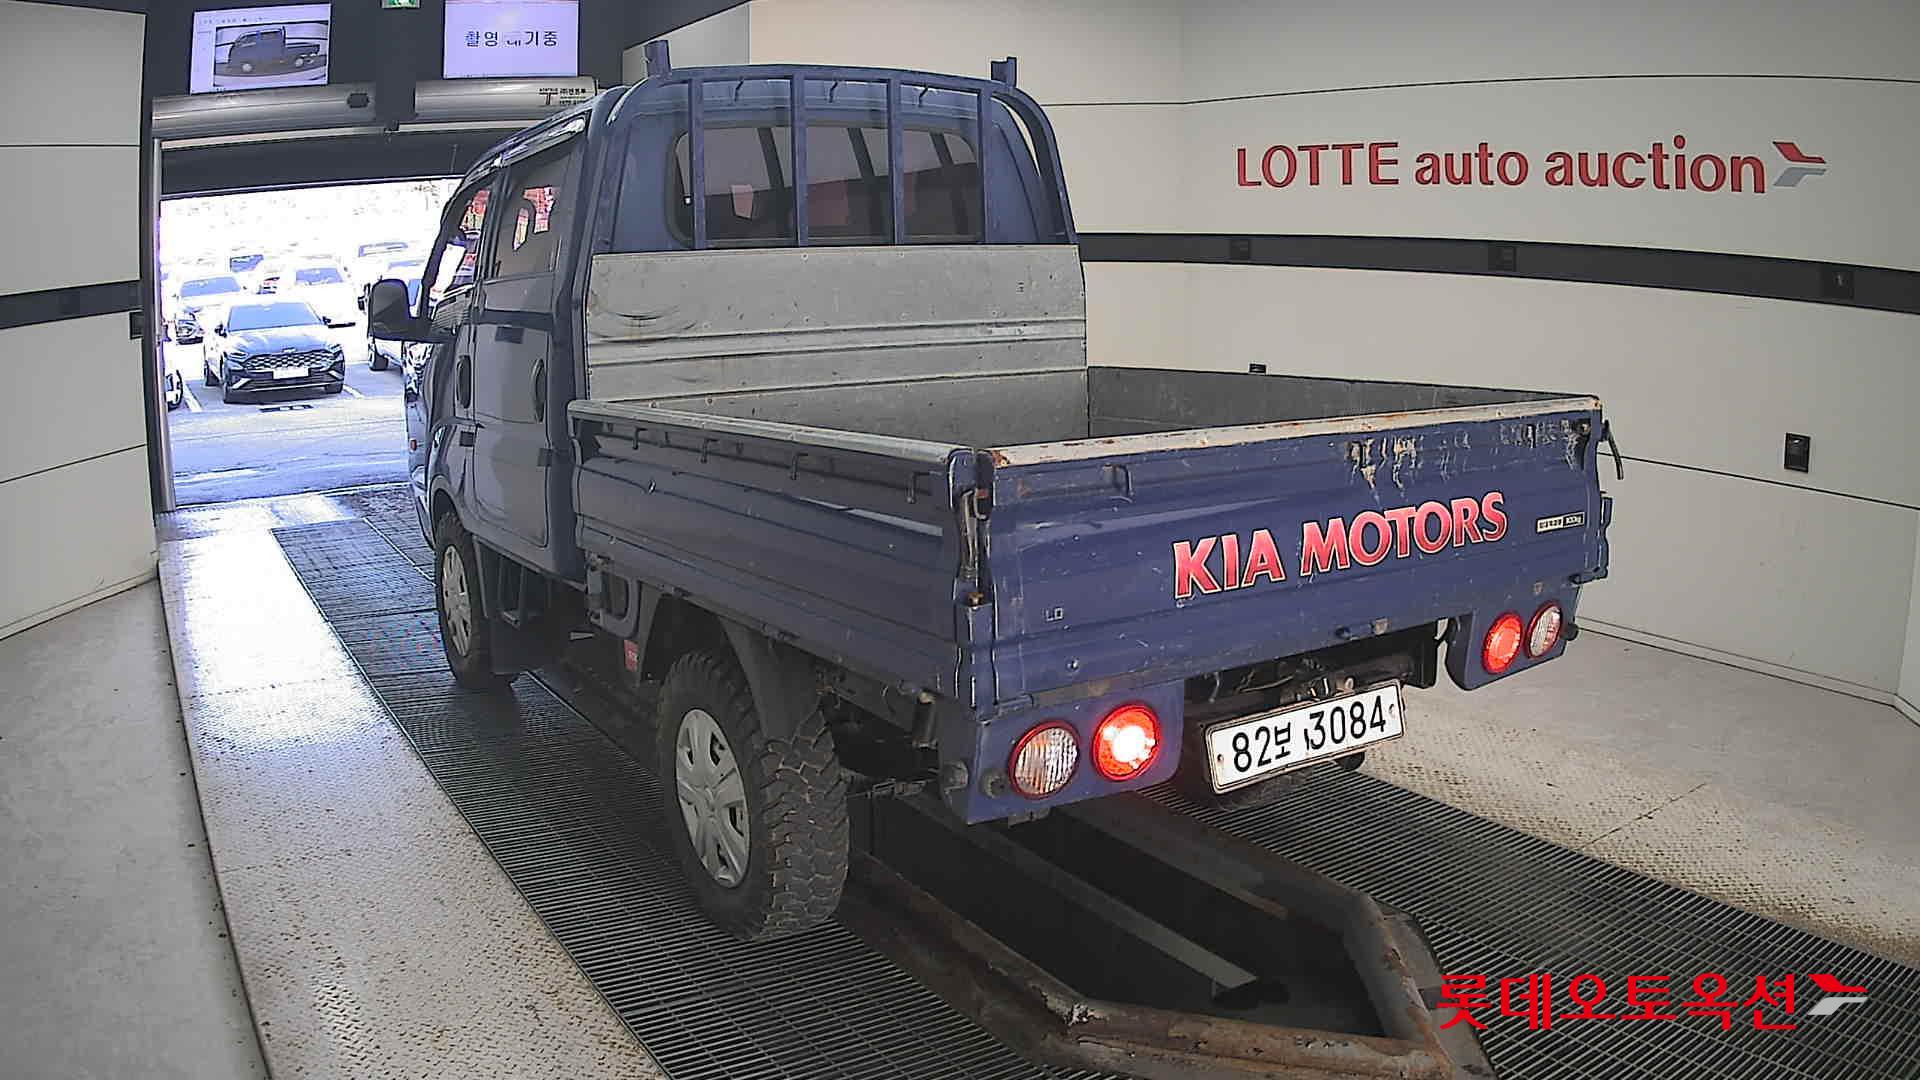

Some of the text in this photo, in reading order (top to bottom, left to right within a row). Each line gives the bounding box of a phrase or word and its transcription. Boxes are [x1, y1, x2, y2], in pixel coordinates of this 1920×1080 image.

[1237, 135, 1766, 194] LOTTE auto auction
[1172, 490, 1510, 600] KIA MOTORS
[1231, 694, 1387, 773] 82보 3084
